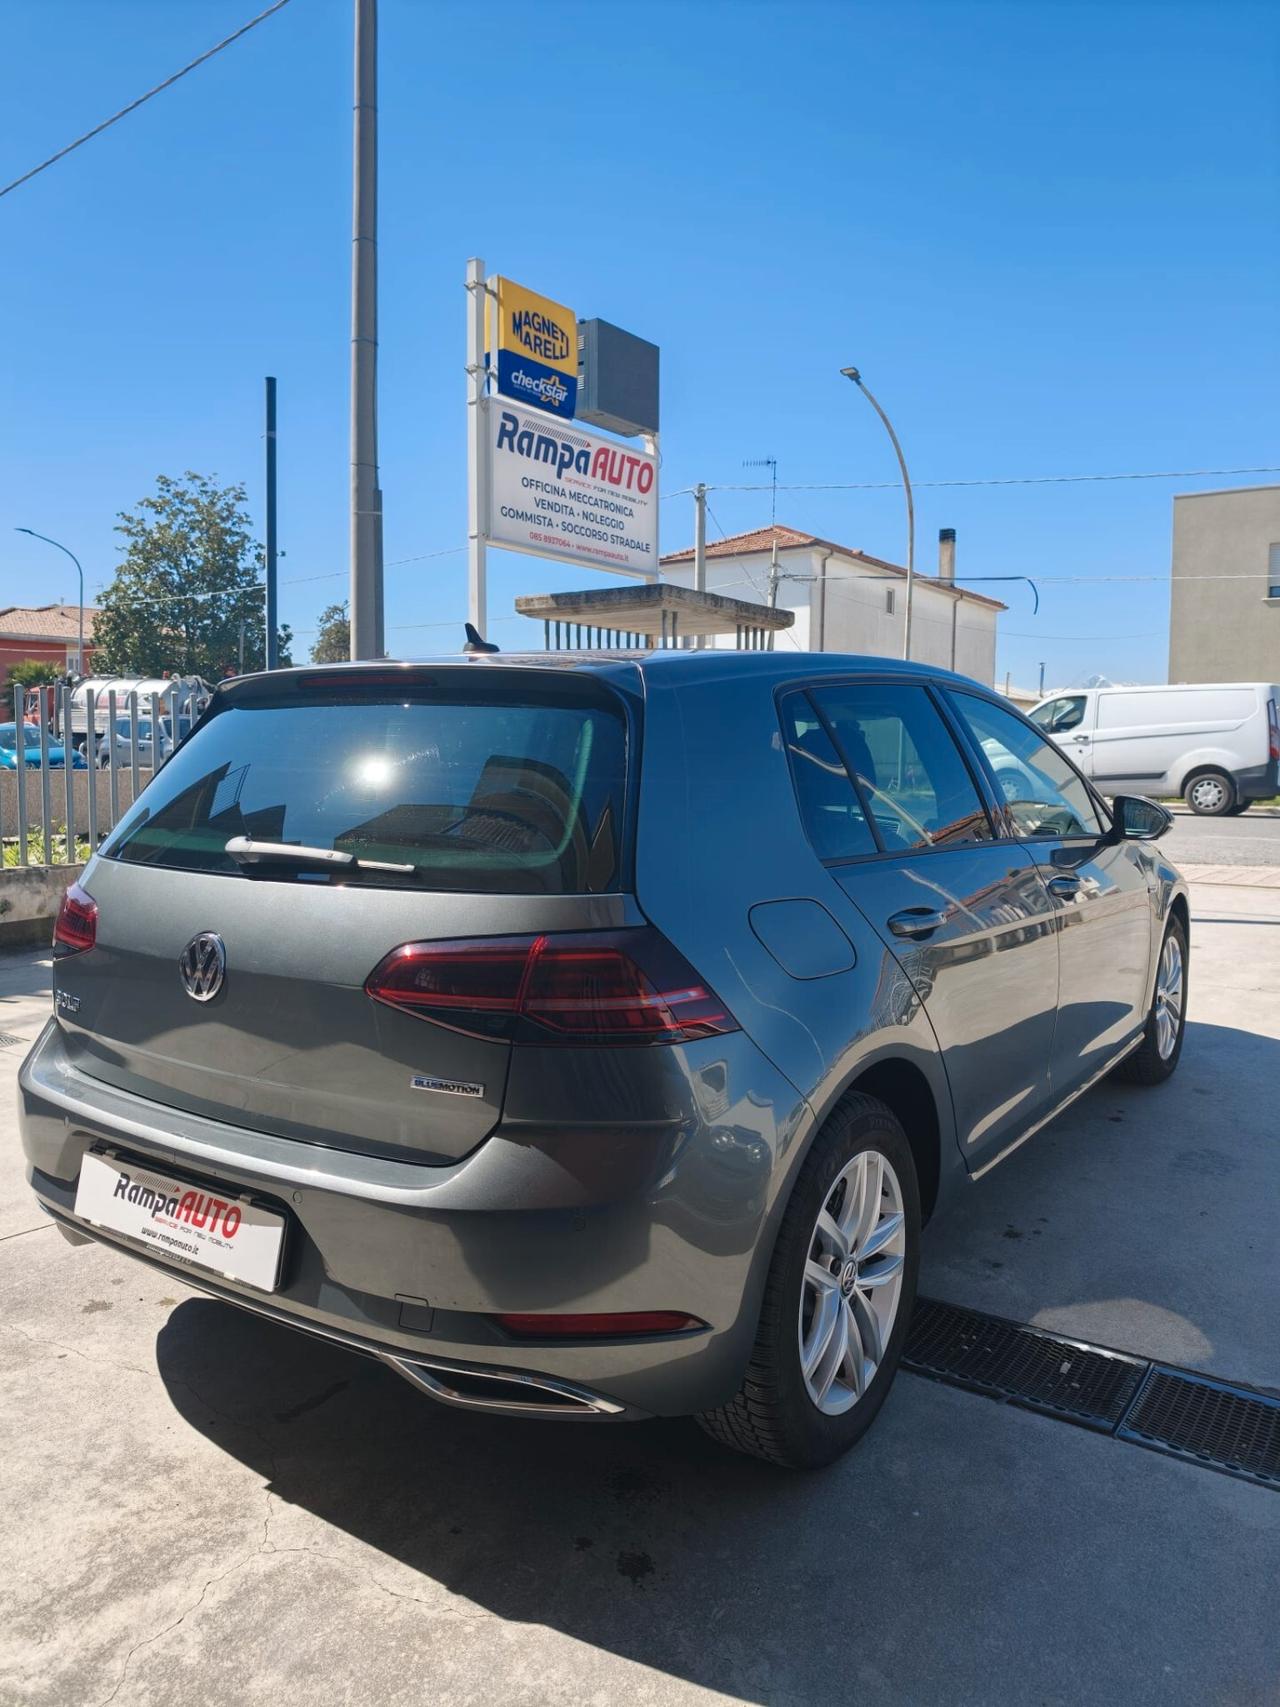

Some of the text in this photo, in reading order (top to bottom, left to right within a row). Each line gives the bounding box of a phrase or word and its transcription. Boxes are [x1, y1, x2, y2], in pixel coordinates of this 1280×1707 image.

[512, 323, 569, 361] MARELLI
[511, 369, 568, 402] checkstar
[521, 476, 634, 518] OFFICINA MECCATRONICA
[534, 497, 625, 531] VENDITA NOLEGGIO
[500, 505, 650, 553] GOMMISTA SOCCORSO STRADALE
[414, 1078, 480, 1094] BLUEMOTION
[141, 1226, 199, 1255] www.rampaauto.it
